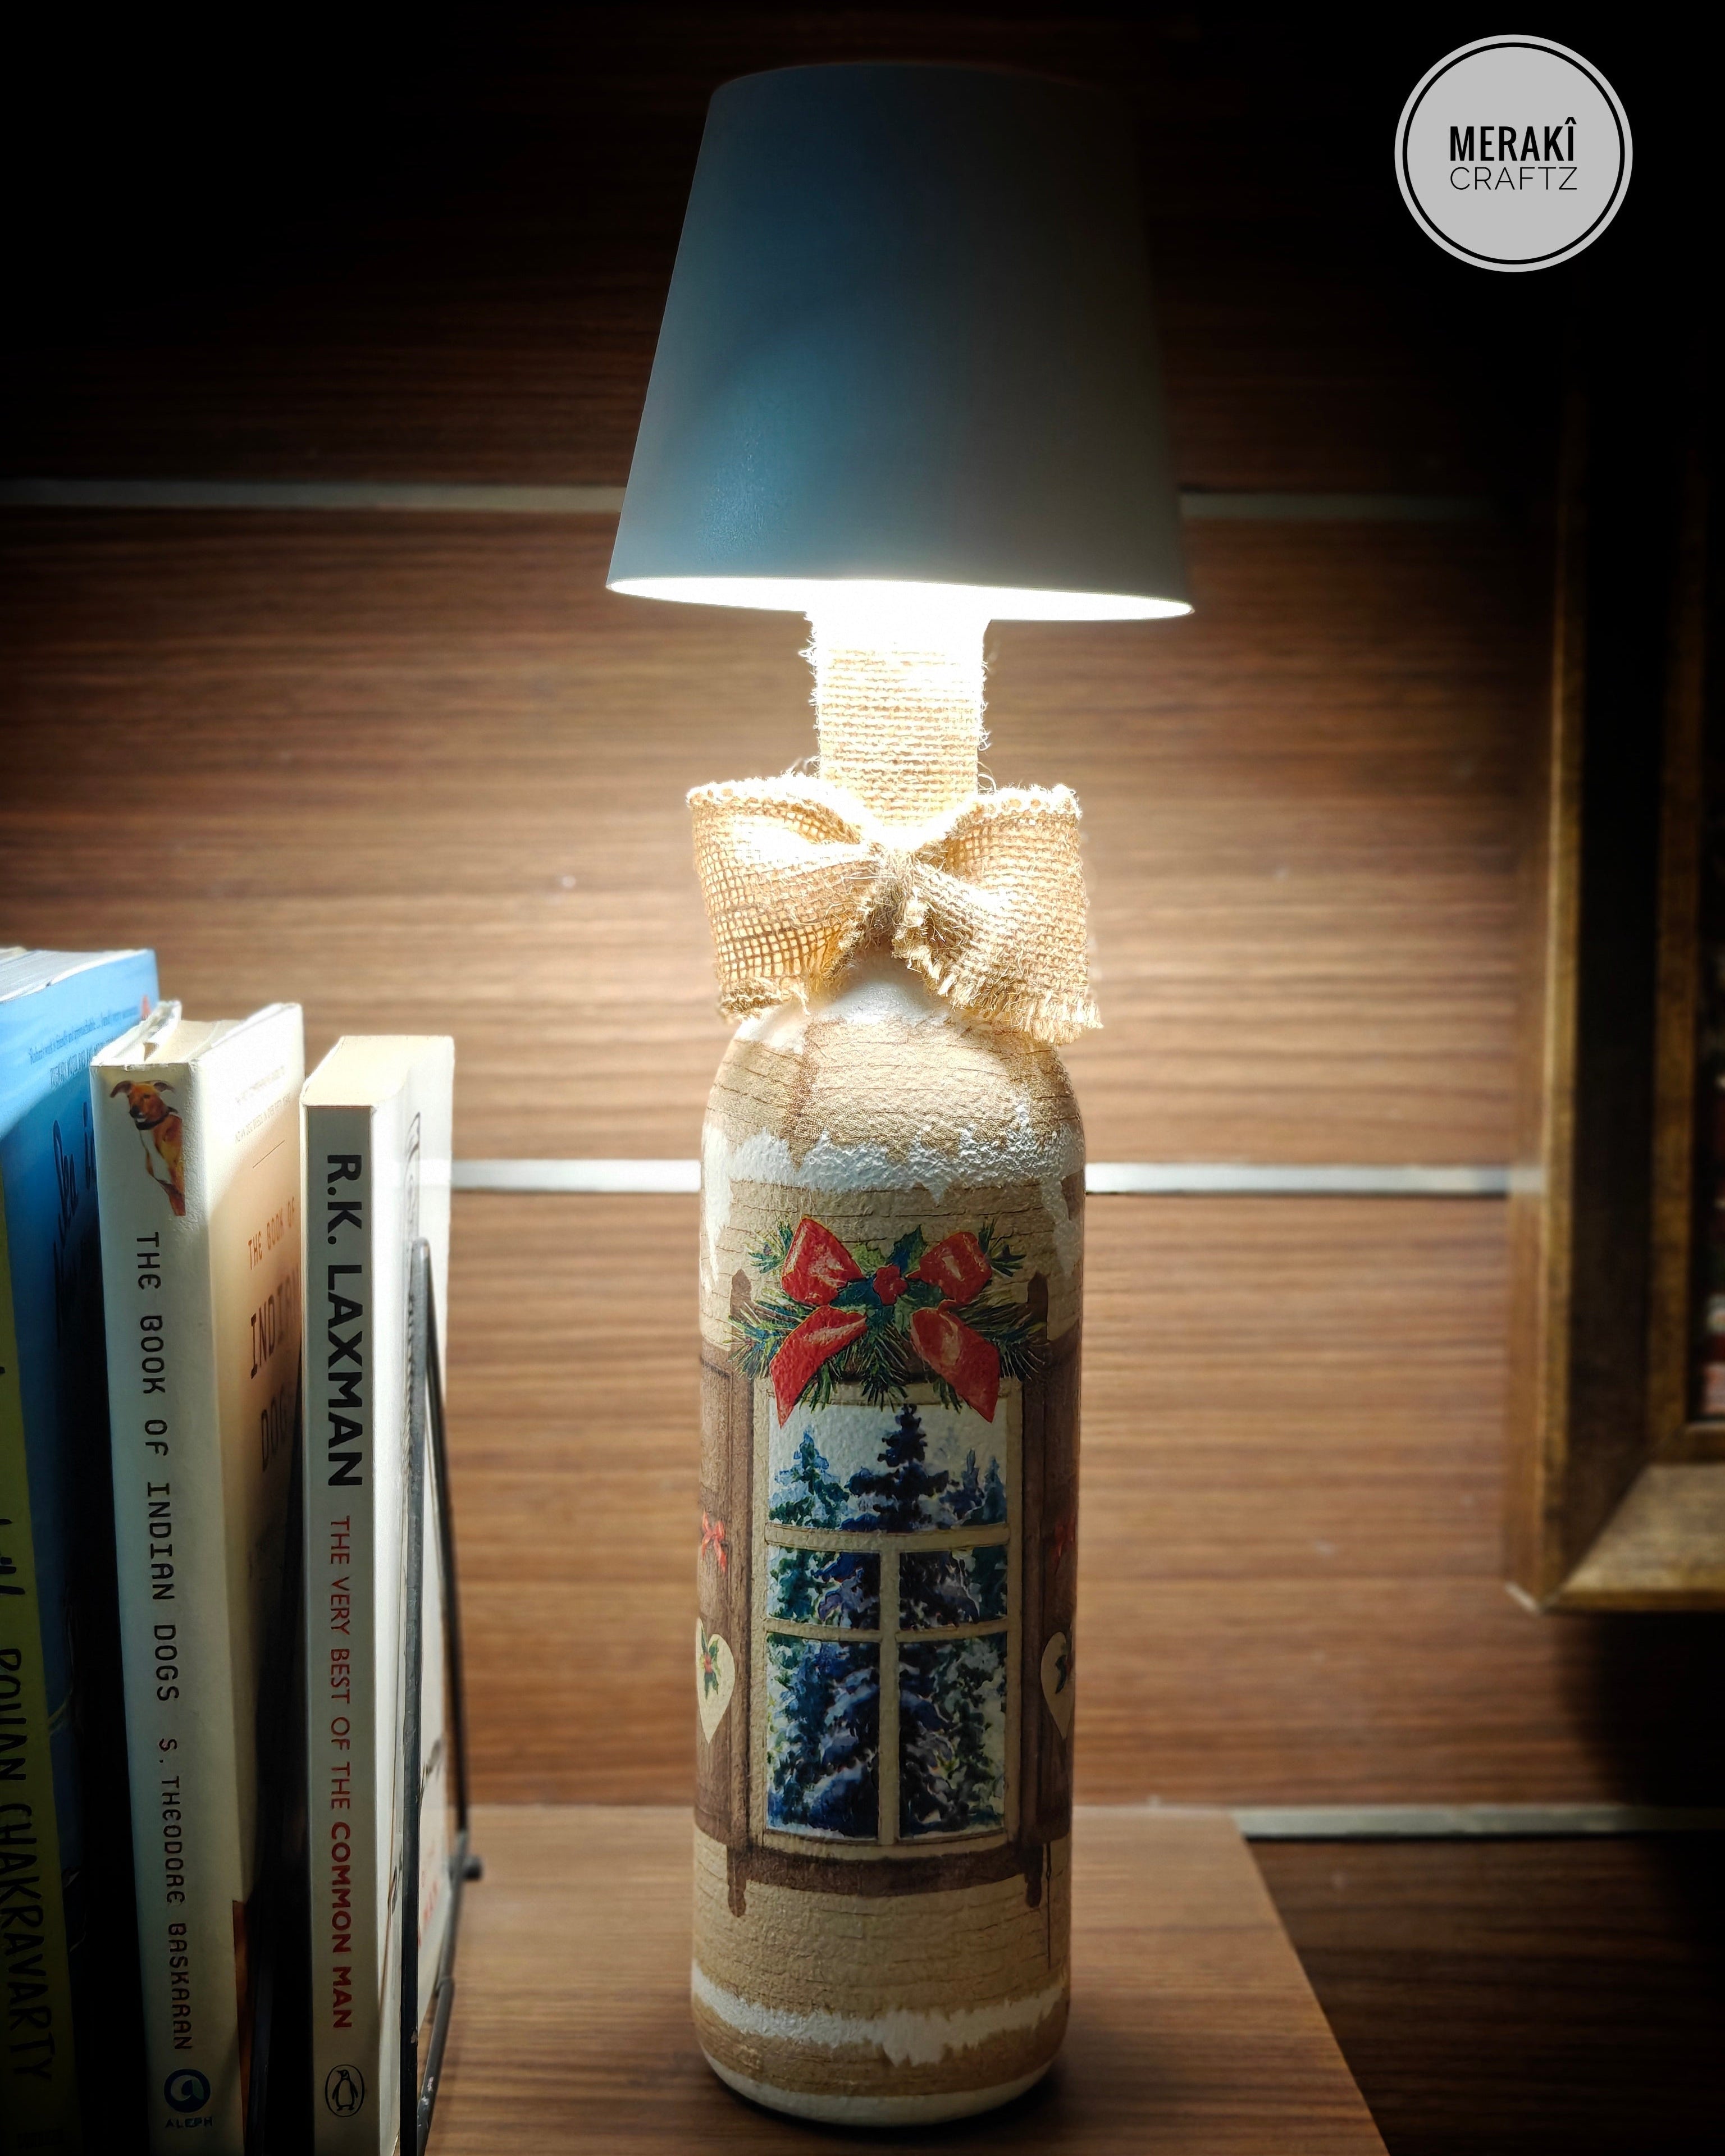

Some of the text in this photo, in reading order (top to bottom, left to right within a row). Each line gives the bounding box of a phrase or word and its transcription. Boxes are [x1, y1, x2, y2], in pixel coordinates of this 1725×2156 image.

[248, 1230, 263, 1271] THE
[267, 1208, 284, 1251] BOOK
[327, 1154, 363, 1486] R.K. LAXMAN
[136, 1231, 180, 1701] THE BOOK OF INDIAN DOGS
[159, 1738, 193, 2050] S. THEODORE BASKARAN
[330, 1515, 352, 2029] THE VERY BEST OF THE COMMON MAN
[0, 1804, 56, 2082] CHAKRAVARTY
